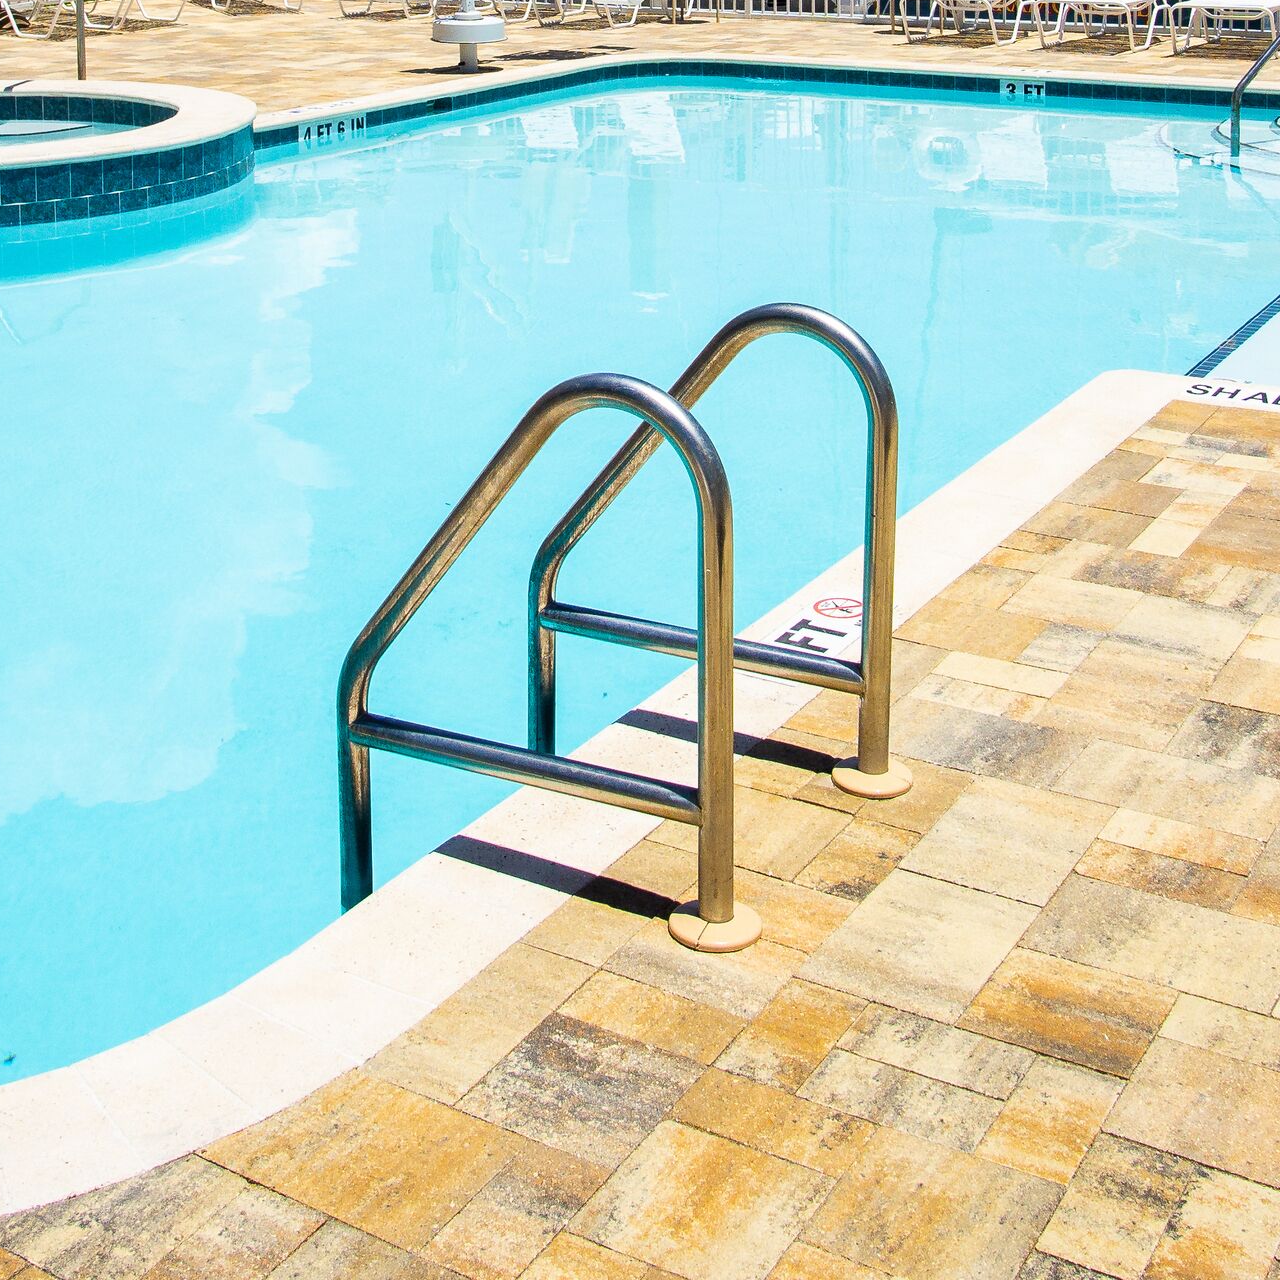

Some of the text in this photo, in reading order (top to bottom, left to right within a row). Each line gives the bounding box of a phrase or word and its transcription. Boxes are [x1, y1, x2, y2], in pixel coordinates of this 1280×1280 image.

[1005, 83, 1045, 95] 3 FT
[317, 122, 333, 138] FT
[337, 120, 346, 134] 6
[350, 116, 365, 132] IN
[773, 618, 849, 654] FT
